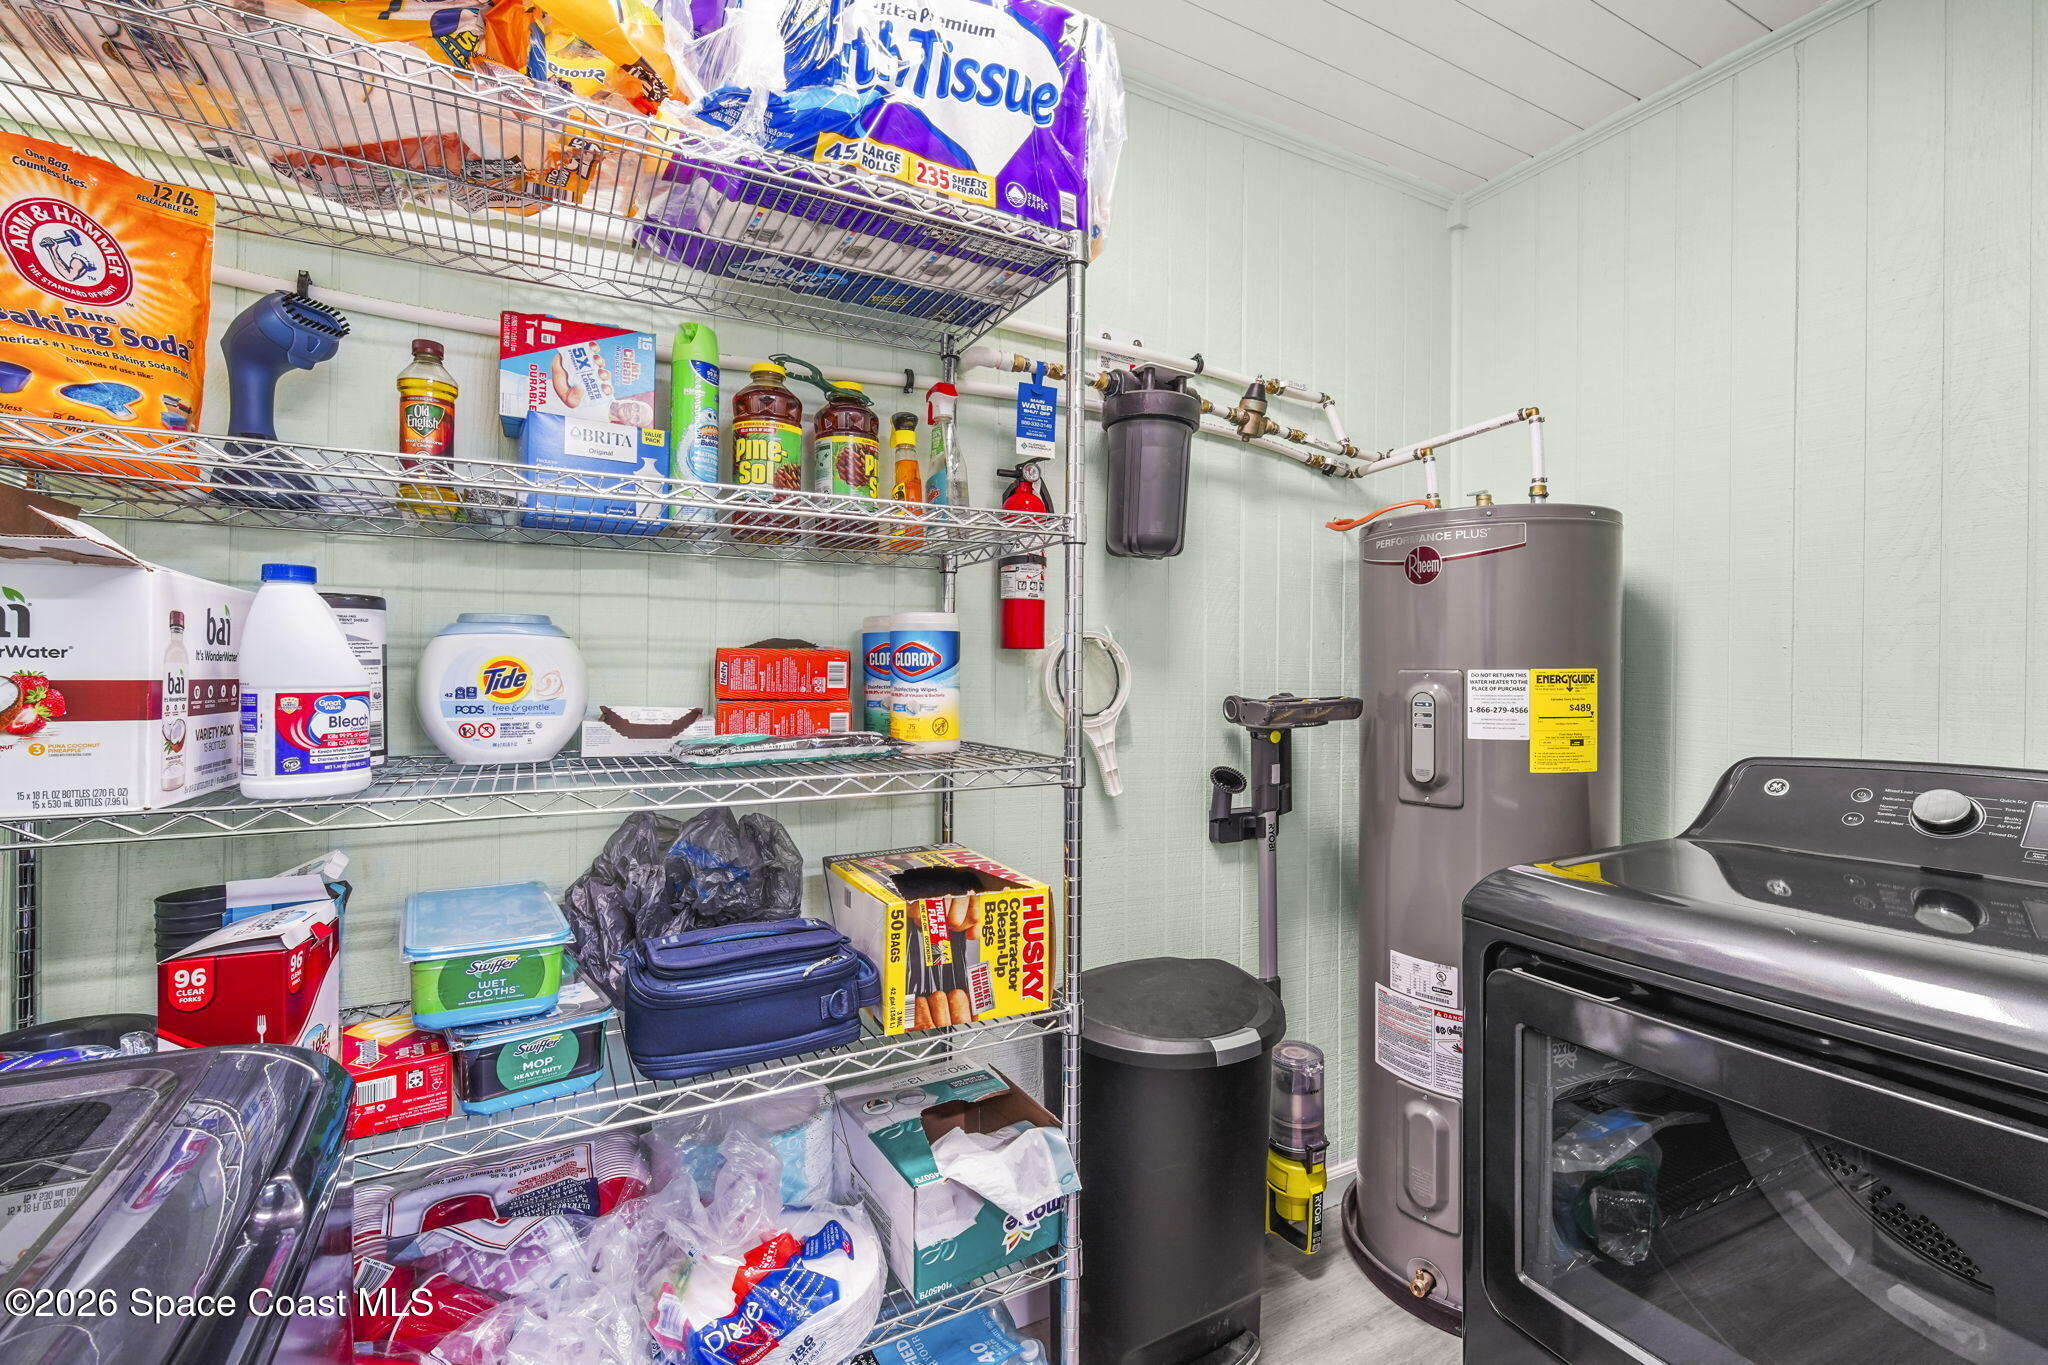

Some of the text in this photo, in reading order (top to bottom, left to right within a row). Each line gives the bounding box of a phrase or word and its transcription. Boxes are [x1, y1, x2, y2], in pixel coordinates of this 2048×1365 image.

[909, 28, 1059, 125] Tissue
[25, 148, 71, 172] One Bag.
[823, 142, 858, 160] 45
[861, 142, 901, 164] LARGE
[12, 155, 88, 189] Countless Uses.
[861, 156, 897, 174] ROLLS
[916, 162, 950, 190] 235
[952, 174, 988, 190] SHEETS
[151, 184, 200, 210] 12 lb.
[952, 184, 988, 199] PER ROLL
[136, 194, 199, 217] RESEALABLE BAG
[10, 204, 125, 278] ARM & HAMMER
[28, 263, 98, 299] THE STANDARD OF
[66, 307, 118, 326] Pure
[120, 325, 191, 362] Soda
[642, 337, 652, 351] 15
[52, 340, 171, 373] #1 Trusted Baking Soda
[573, 347, 591, 369] 5X
[622, 348, 634, 385] Clean
[528, 364, 538, 411] DURABLE
[538, 372, 547, 405] EXTRA
[587, 373, 602, 400] LASTS
[414, 404, 430, 418] Old
[1021, 401, 1053, 412] WATER
[407, 415, 439, 430] English
[583, 429, 632, 447] BRITA
[589, 448, 614, 456] Original
[735, 438, 788, 463] Pine-
[739, 461, 774, 484] Sol
[1455, 528, 1488, 539] PLUS
[1408, 546, 1440, 579] Rheem
[206, 604, 231, 646] bai
[195, 650, 239, 663] It's WonderWater
[895, 652, 935, 667] CLOROX
[168, 668, 185, 695] bai
[484, 667, 527, 695] Tide
[720, 662, 728, 685] Hefty
[319, 699, 342, 707] Great
[455, 705, 484, 714] PODS
[492, 704, 509, 712] free
[522, 704, 549, 713] gentle
[1569, 703, 1591, 712] $489
[329, 714, 368, 728] Bleach
[195, 724, 235, 741] VARIETY PACK
[208, 740, 227, 752] BOTTLES
[17, 788, 129, 801] 15 18 FL OZ BOTTLES (270 FL OZ)
[32, 797, 129, 809] 15 530 mL BOTTLES (7.95 L)
[1268, 823, 1276, 852] RYOBI
[861, 846, 922, 858] CONTRACTOR
[891, 909, 904, 931] 50
[927, 908, 938, 935] FLAPS
[935, 901, 948, 939] TRUE TIE
[981, 901, 997, 947] Bags
[891, 933, 901, 963] BAGS
[1008, 898, 1021, 992] Contractor
[1021, 895, 1046, 1003] HUSKY
[290, 952, 303, 973] 96
[466, 955, 518, 978] Swiffer
[174, 968, 207, 989] 96
[478, 978, 507, 989] WET
[176, 987, 205, 997] CLEAR
[179, 995, 202, 1004] FORKS
[468, 986, 516, 1000] CLOTHS
[891, 986, 896, 995] 42
[971, 970, 985, 1010] TOUGHER
[513, 1037, 562, 1057] Swiffer
[513, 1068, 540, 1080] HEAVY
[541, 1064, 562, 1074] DUTY
[522, 1056, 553, 1071] MOP
[948, 1063, 974, 1074] 180
[907, 1076, 926, 1085] 13
[1314, 1194, 1323, 1225] RYOBI
[704, 1302, 763, 1354] Dixie
[788, 1334, 815, 1362] 186
[795, 1343, 816, 1365] PLATES
[969, 1342, 996, 1363] 40
